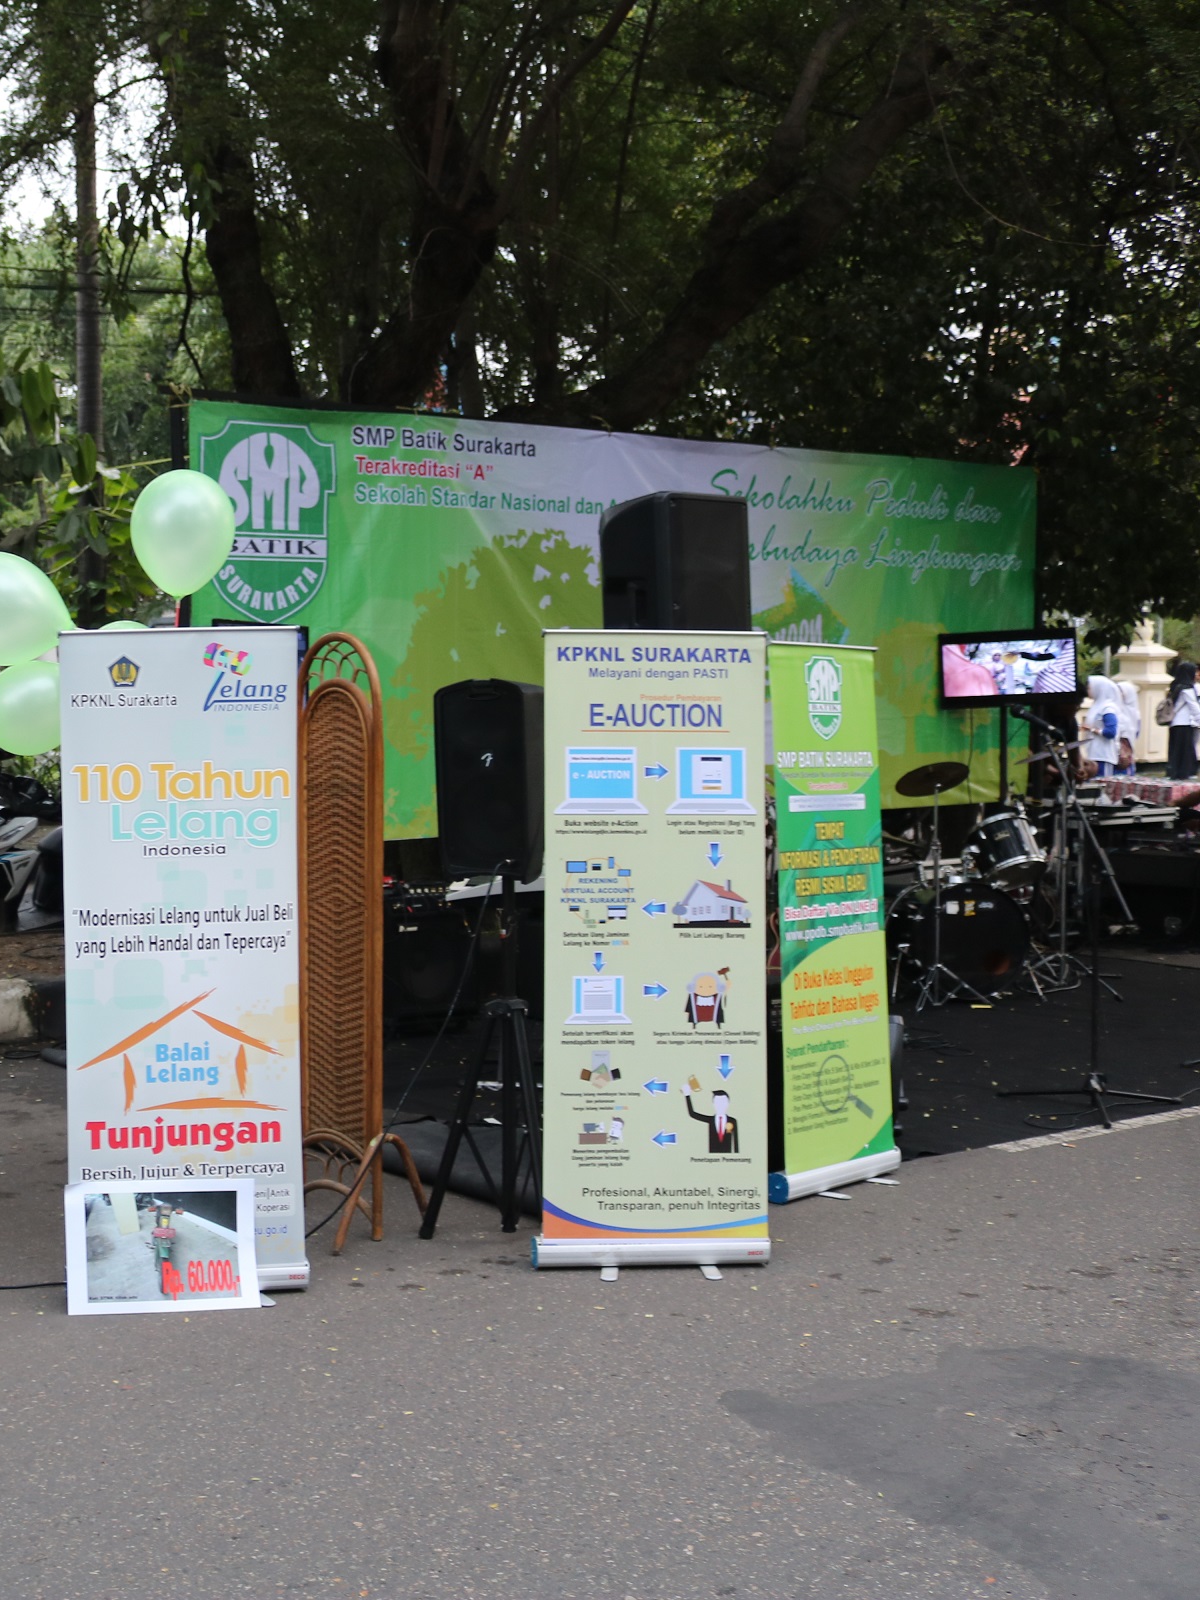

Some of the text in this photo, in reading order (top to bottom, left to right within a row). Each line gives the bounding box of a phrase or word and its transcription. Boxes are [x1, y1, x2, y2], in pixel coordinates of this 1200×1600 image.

[352, 426, 536, 457] SMP Batik Surakarta
[355, 456, 494, 481] Terakreditasi "A"
[218, 432, 320, 531] SMP
[355, 483, 426, 505] Sekolah
[432, 487, 495, 510] Standar
[501, 492, 570, 514] Nasional
[575, 497, 604, 515] dan
[864, 477, 950, 522] Peduli
[954, 487, 1003, 524] dan
[230, 538, 318, 555] BATIK
[863, 526, 1023, 588] Lingkungan
[218, 564, 319, 611] SURAKARTA
[556, 646, 752, 664] KPKNL SURAKARTA
[588, 667, 729, 681] Melayani dengan PASTI
[71, 693, 178, 708] KPKNL Surakarta
[203, 671, 288, 712] Lelang
[213, 702, 280, 712] INDONESIA
[589, 703, 723, 728] E-AUCTION
[777, 751, 874, 769] SMP BATIK SURAKARTA
[71, 760, 291, 802] 110 Tahun
[587, 770, 631, 779] AUCTION
[110, 801, 280, 847] Lelang
[142, 843, 227, 858] Indonesia
[159, 906, 200, 928] Lelang
[203, 905, 241, 924] untuk
[245, 904, 270, 922] Jual
[273, 903, 293, 921] Beli
[75, 938, 107, 958] yang
[111, 935, 145, 954] Lebih
[149, 934, 193, 953] Handal
[197, 933, 220, 951] dan
[155, 1041, 211, 1063] Balai
[145, 1062, 220, 1086] Lelang
[85, 1116, 282, 1155] Tunjungan
[81, 1162, 286, 1182] Bersih, Jujur & Terpercaya
[582, 1187, 762, 1199] Profesional, Akuntabel, Sinergi,
[256, 1203, 290, 1214] Koperasi
[598, 1200, 761, 1212] Transparan, penuh Integritas
[161, 1259, 241, 1301] Rp. 60.000,-
